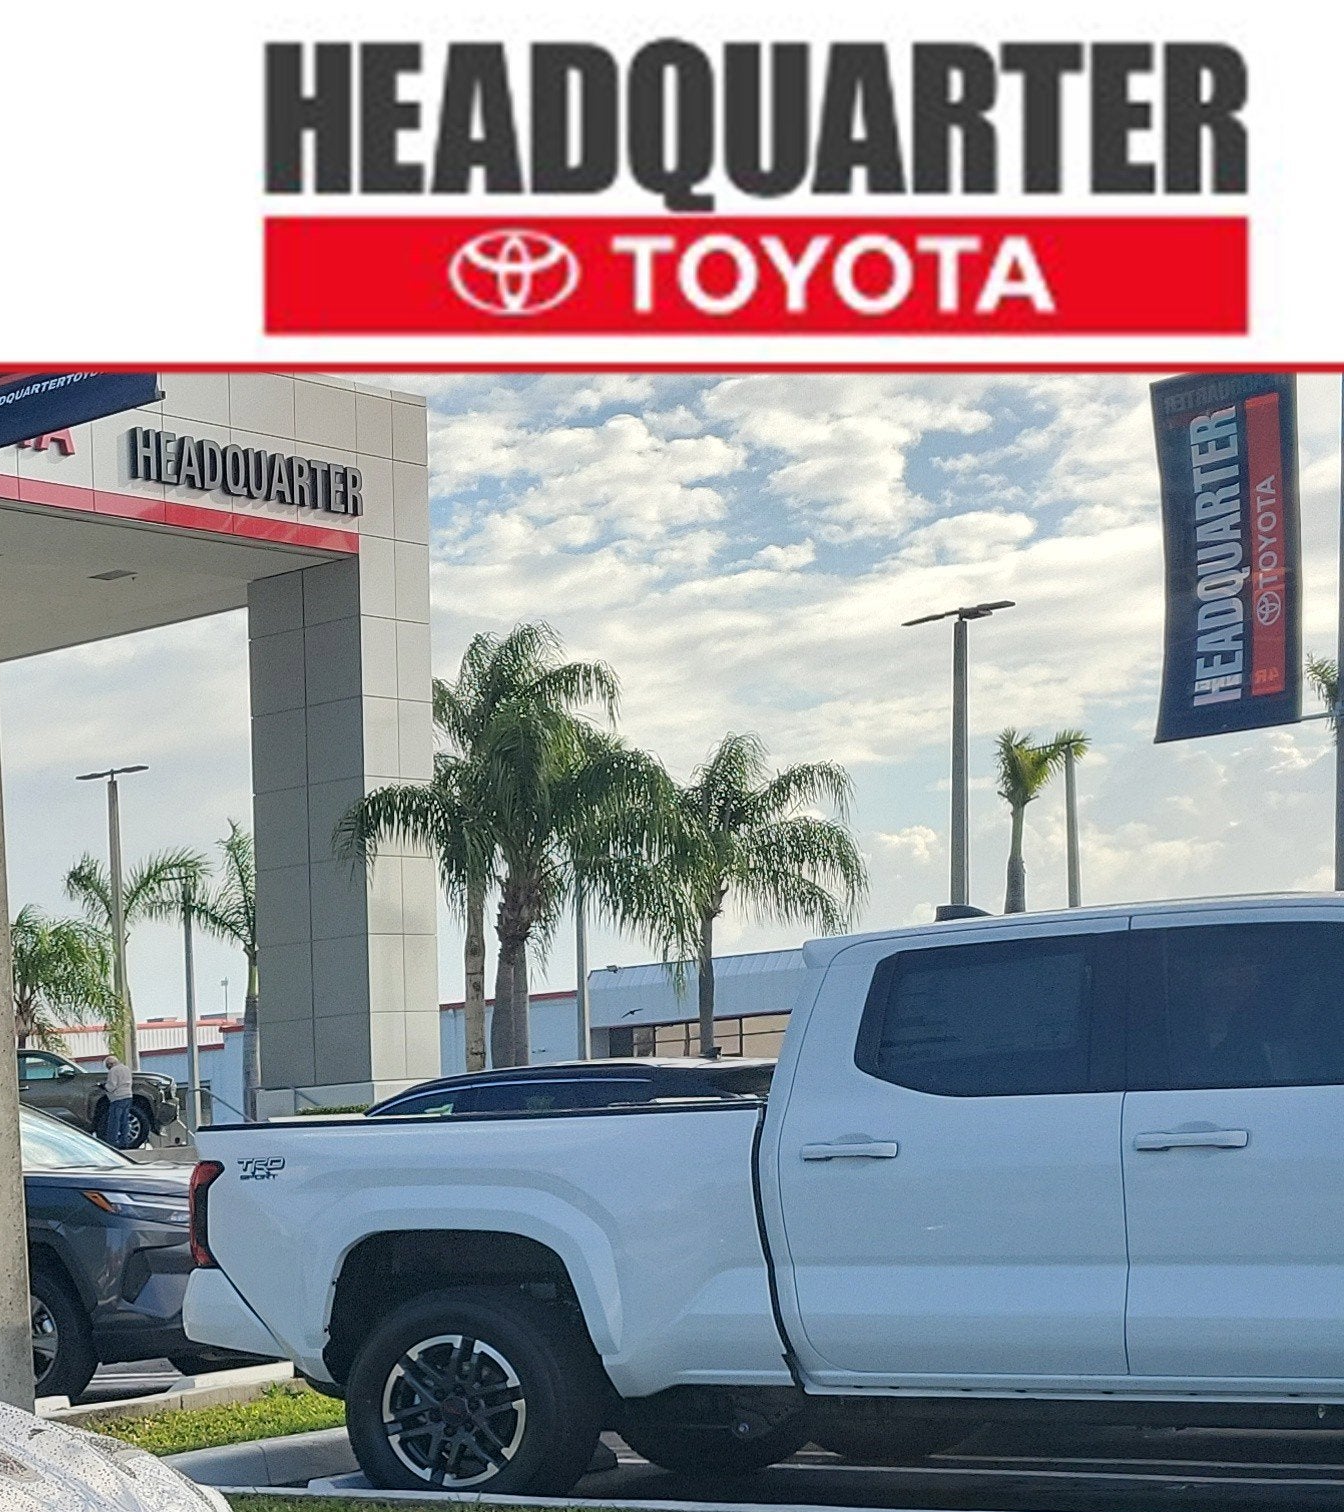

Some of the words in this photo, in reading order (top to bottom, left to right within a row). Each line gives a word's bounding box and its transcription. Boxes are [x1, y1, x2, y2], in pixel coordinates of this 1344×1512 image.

[130, 426, 363, 517] HEADQUARTER
[1189, 405, 1250, 706] HEADQUARTER
[1256, 475, 1278, 589] TOYOTA
[237, 1156, 285, 1174] TRD
